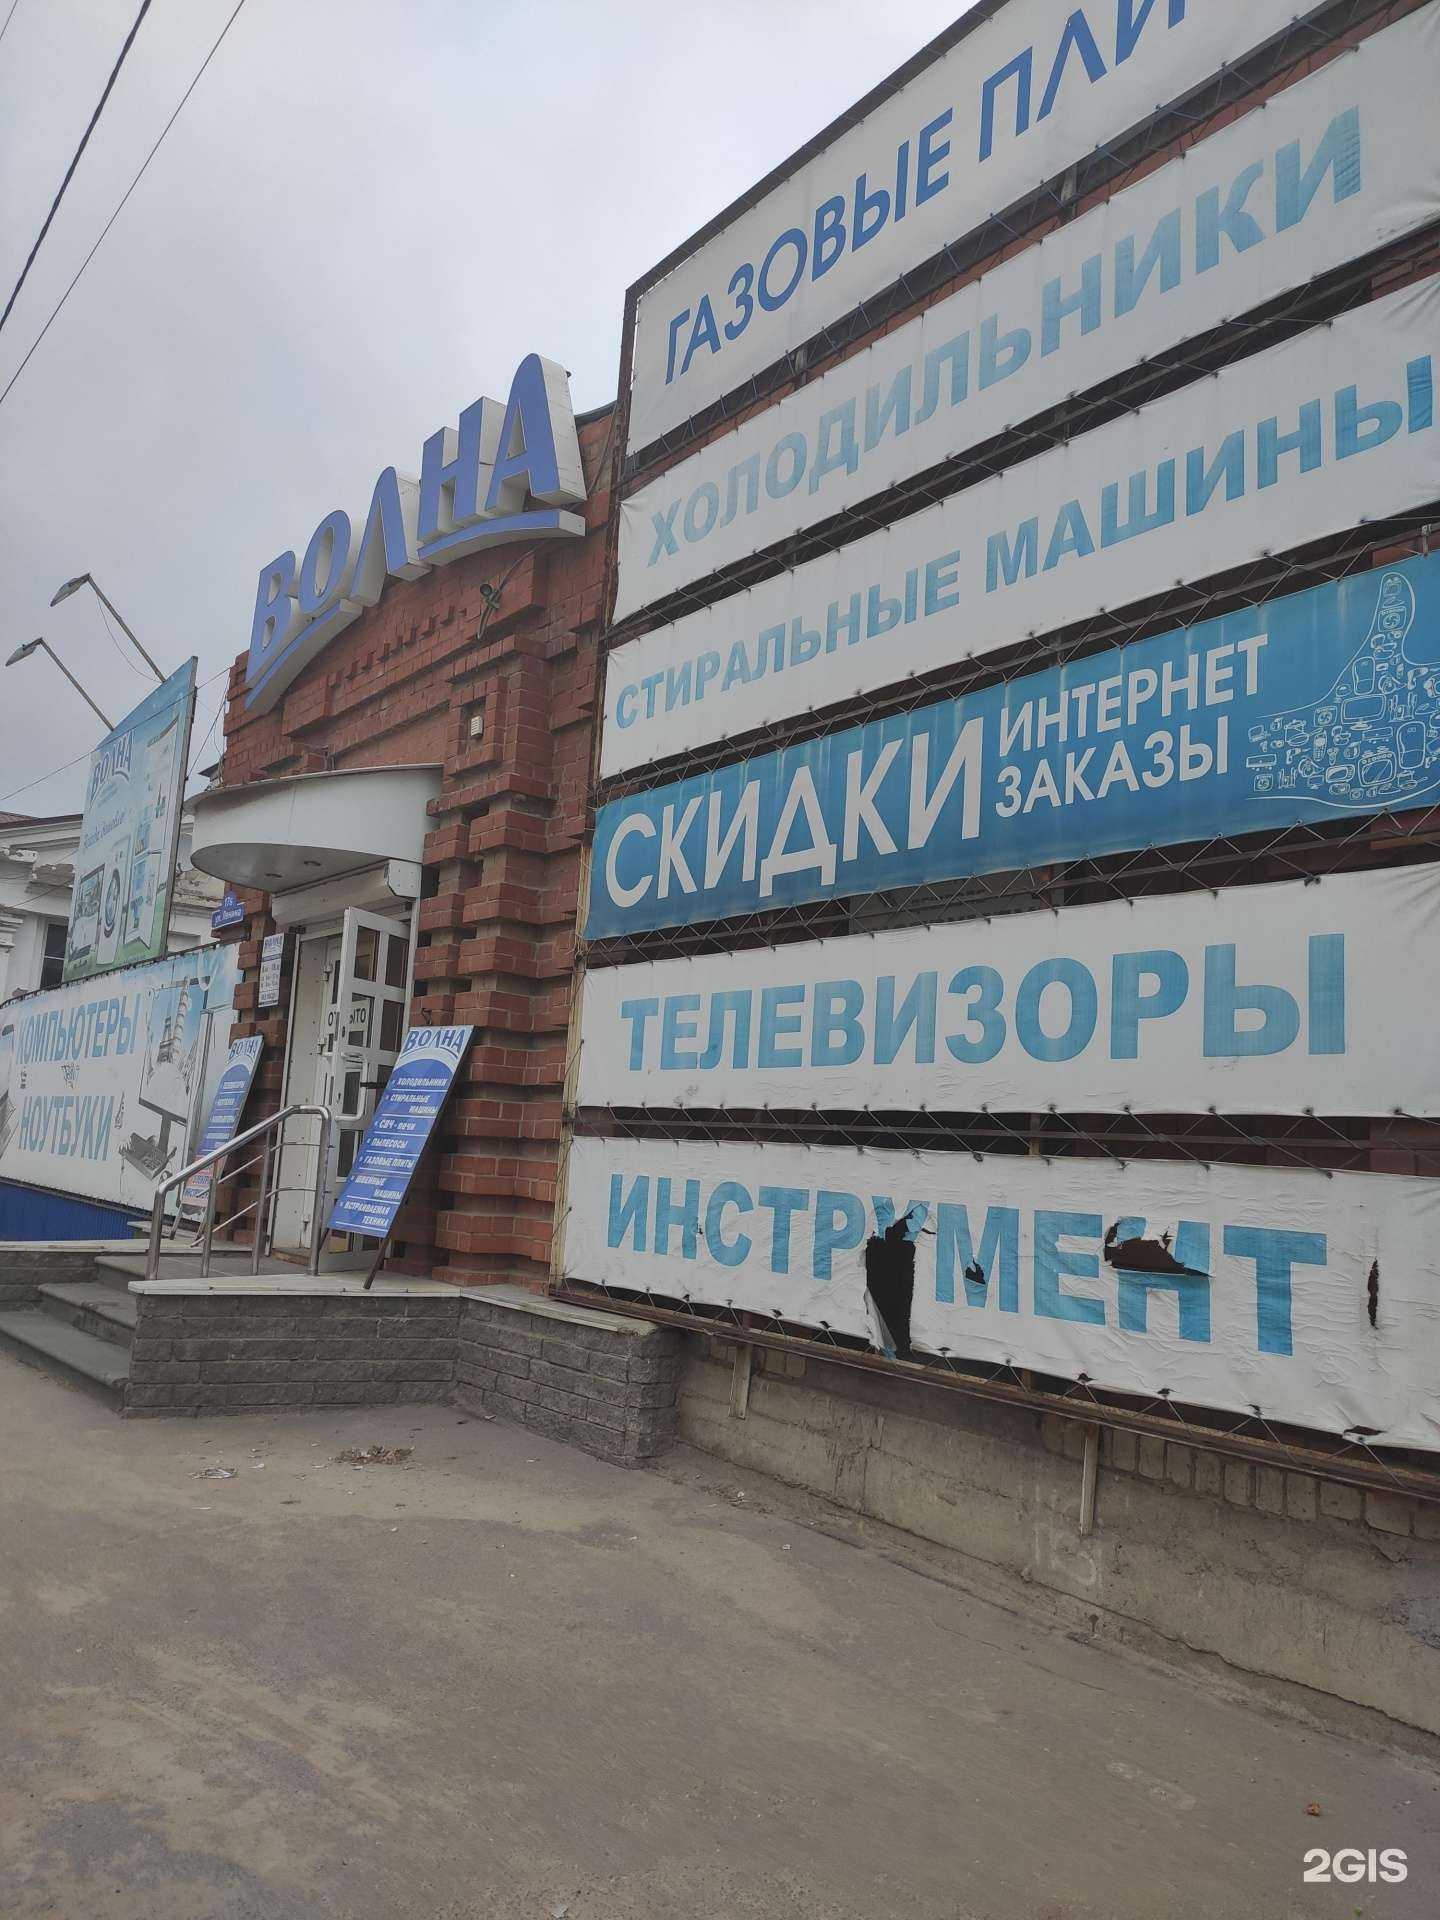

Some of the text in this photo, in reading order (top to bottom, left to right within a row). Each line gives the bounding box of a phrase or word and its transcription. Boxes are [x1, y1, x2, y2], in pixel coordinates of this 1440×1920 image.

[665, 107, 953, 385] ГАЗОВЫЕ
[648, 105, 1362, 566] ХОЛОДИЛЬНИКИ
[245, 353, 580, 688] ВОЛНА
[615, 355, 1433, 730] СТИРАЛЬНЫЕ МАШИНЫ
[1000, 634, 1269, 757] ИНТЕРНЕТ
[995, 716, 1229, 818] ЗАКАЗЫ
[605, 717, 985, 908] СКИДКИ
[16, 993, 141, 1064] КОМПЬЮТЕРЫ
[621, 933, 1345, 1071] ТЕЛЕВИЗОРЫ
[229, 1039, 258, 1060] ВОЛНА
[405, 1028, 466, 1054] ВОЛНА
[390, 1094, 430, 1103] СТИРАЛЬНЫЕ
[397, 1078, 448, 1087] ХОЛОДИЛЬНИКИ
[409, 1105, 438, 1114] МАШИНЫ
[18, 1096, 115, 1161] НОУТБУКИ
[363, 1155, 415, 1168] ГАЗОВЫЕ ПЛИТЫ
[371, 1138, 408, 1149] ПЫЛЕСОСЫ
[362, 1216, 389, 1227] ТЕХНИКА
